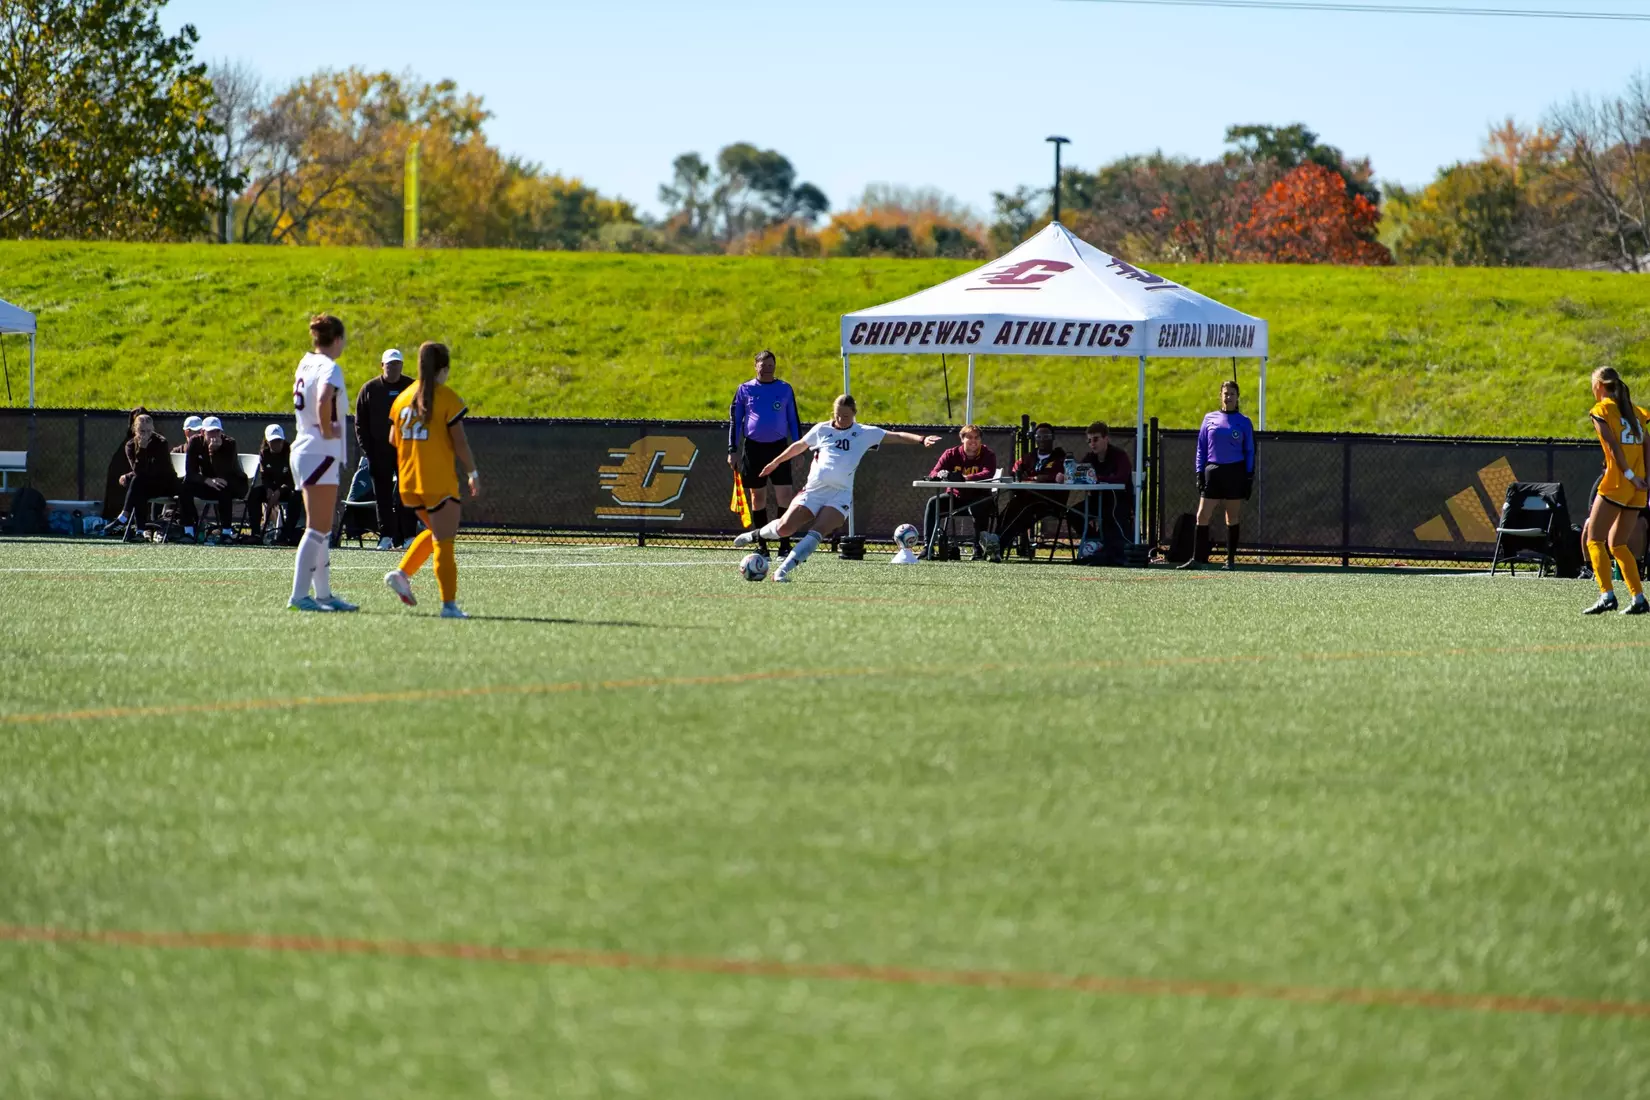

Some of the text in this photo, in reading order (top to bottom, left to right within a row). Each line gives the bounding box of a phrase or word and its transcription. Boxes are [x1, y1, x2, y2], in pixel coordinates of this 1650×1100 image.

[849, 319, 1135, 348] CHIPPEWAS ATHLETICS
[1158, 323, 1256, 349] CENTRAL MICHIGAN
[400, 406, 429, 440] 22
[834, 438, 850, 451] 20
